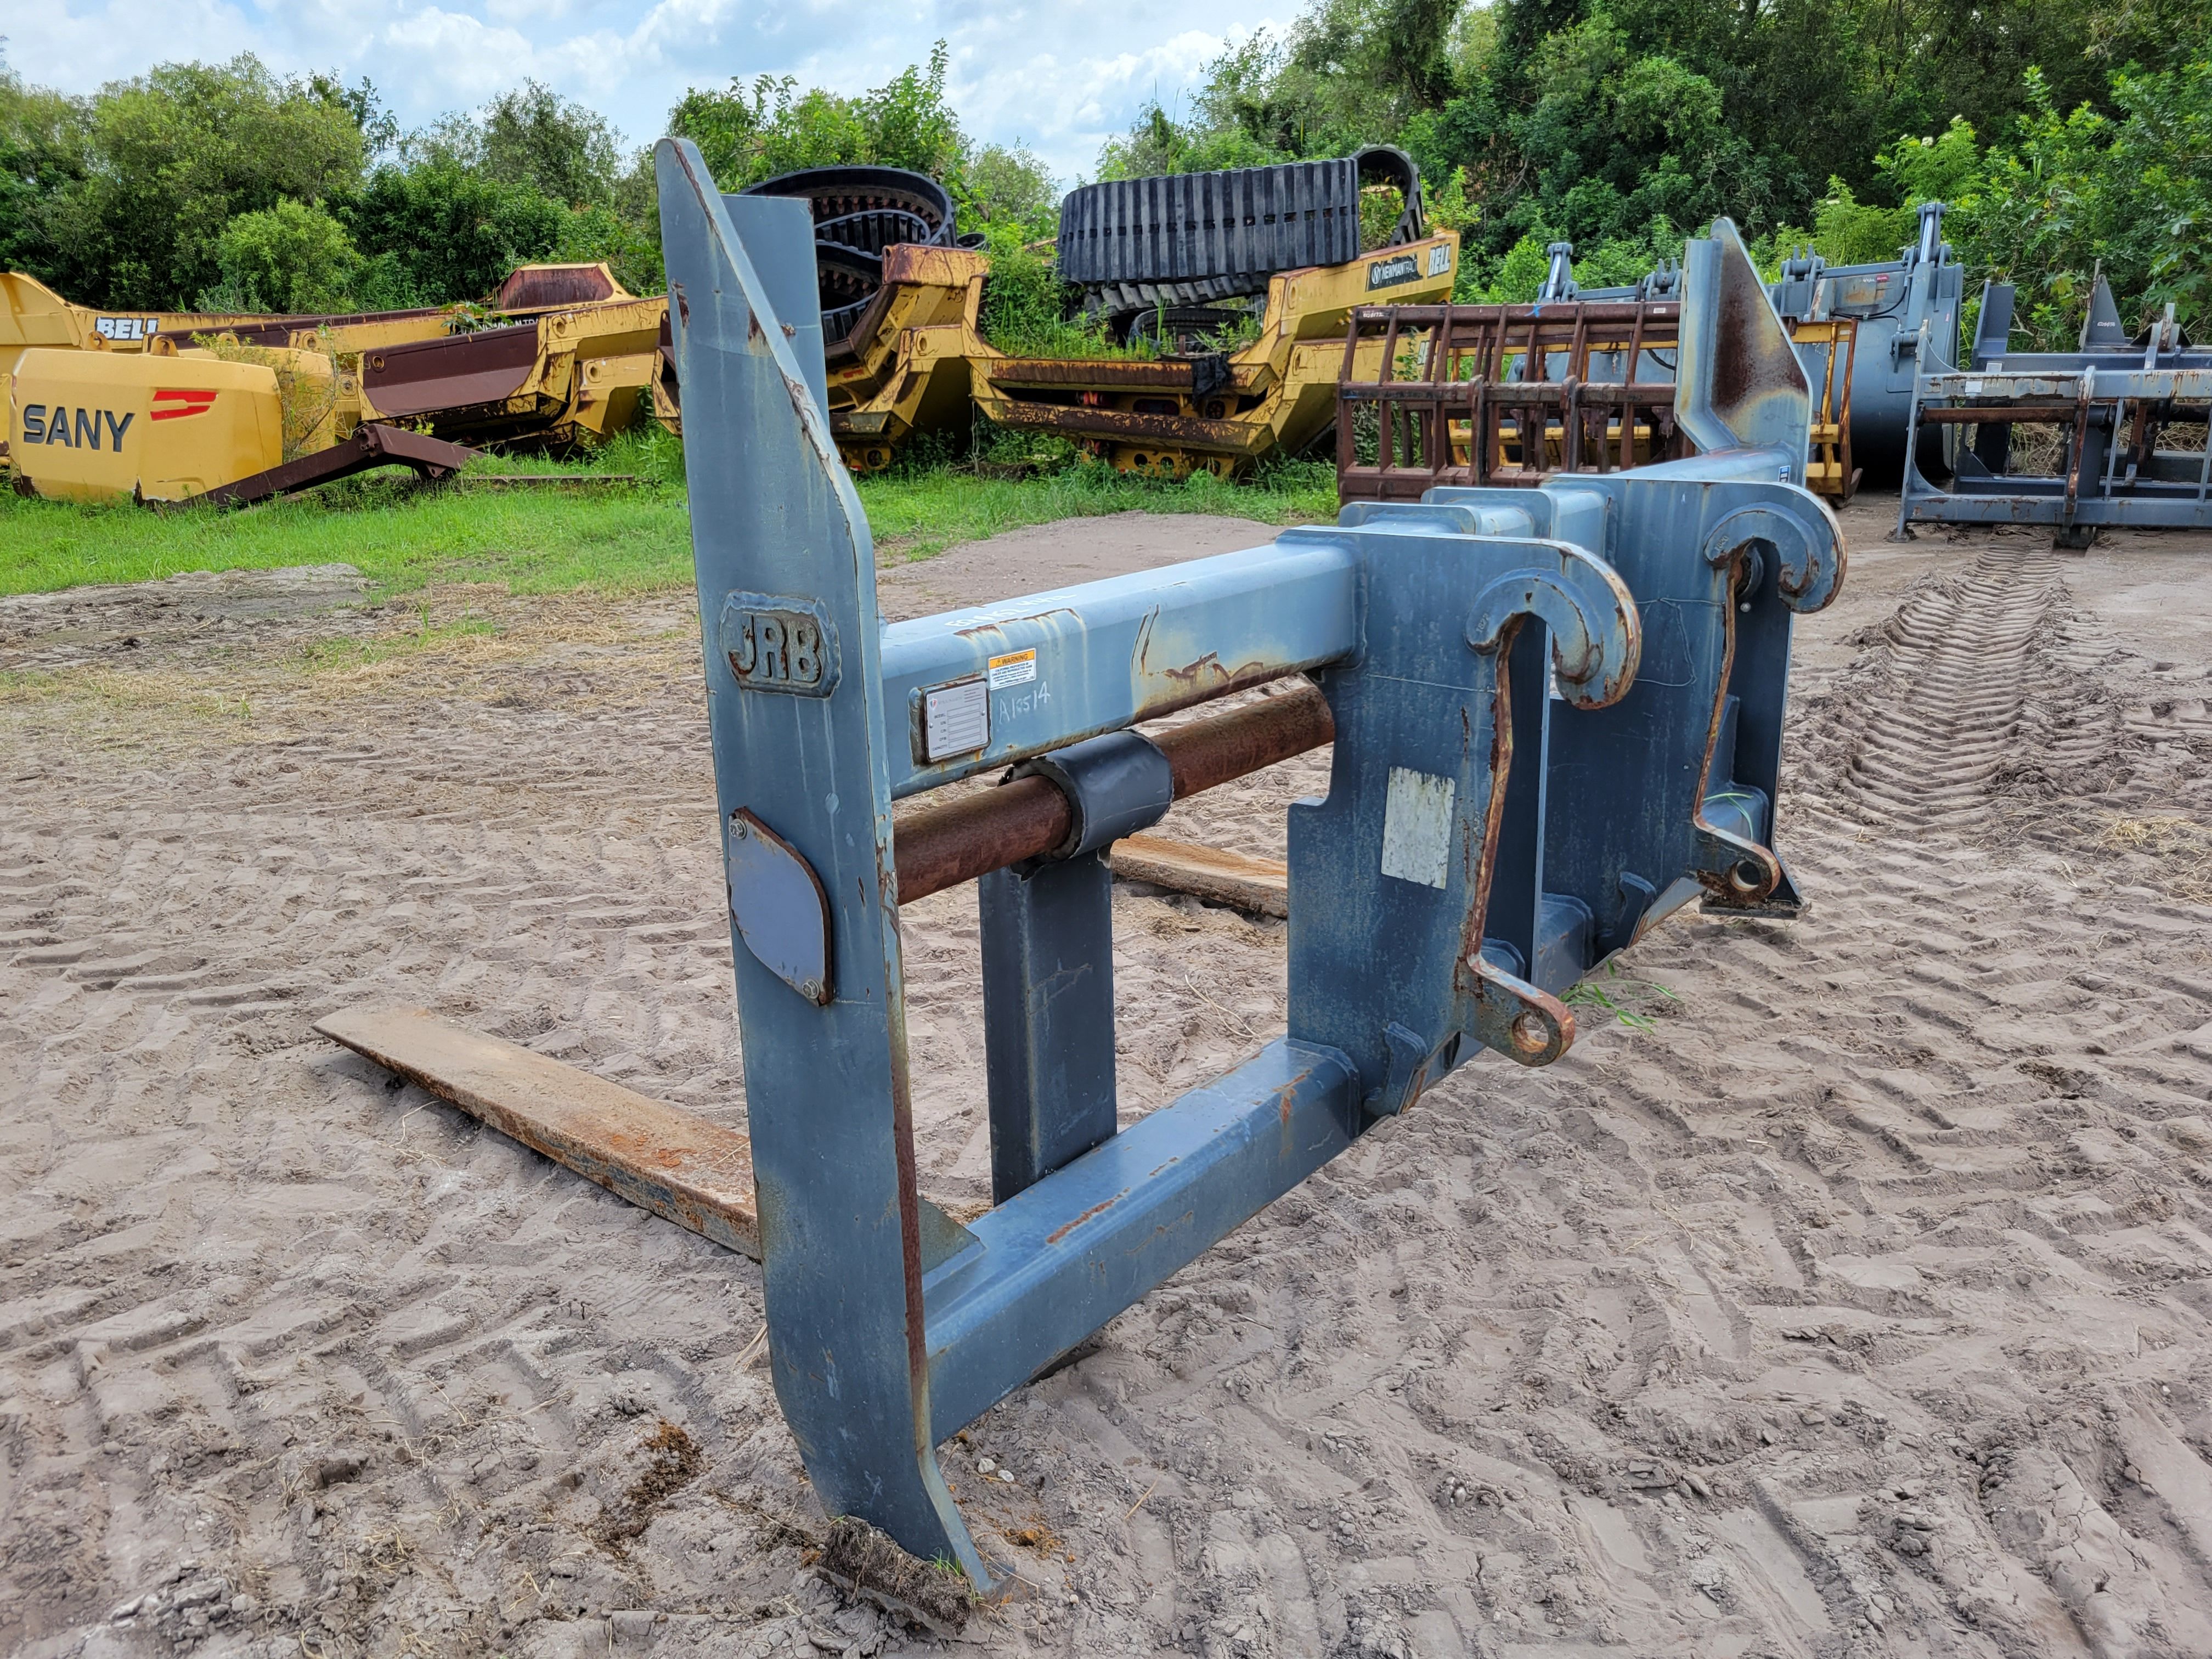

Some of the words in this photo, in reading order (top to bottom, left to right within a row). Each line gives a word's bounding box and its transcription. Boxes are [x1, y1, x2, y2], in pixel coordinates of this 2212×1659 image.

[1427, 244, 1451, 276] BELL
[23, 404, 136, 453] SANY
[728, 612, 822, 683] JRB
[1002, 653, 1028, 665] WARNING
